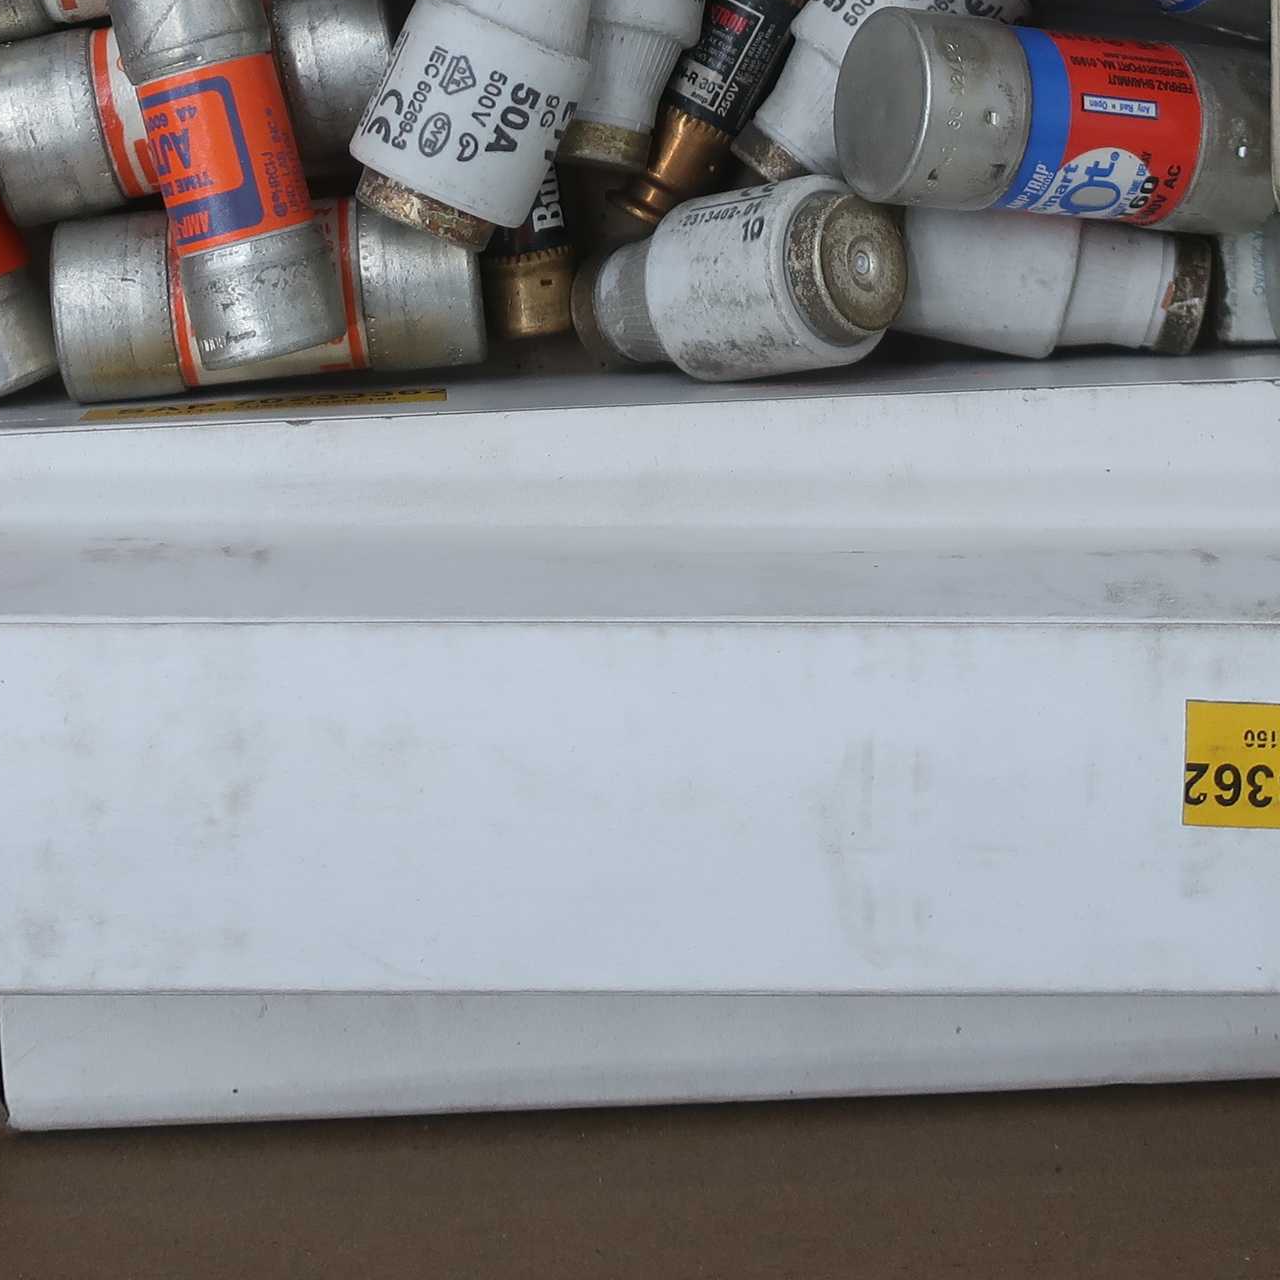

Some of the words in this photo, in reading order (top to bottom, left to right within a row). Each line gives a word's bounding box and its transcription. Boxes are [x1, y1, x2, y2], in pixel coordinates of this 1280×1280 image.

[424, 45, 448, 79] IEC
[471, 70, 508, 128] 500V
[717, 82, 740, 117] 250V
[1108, 75, 1155, 90] SHAWMUT
[1156, 79, 1193, 94] FERRAZ
[392, 80, 432, 151] 60269-3
[485, 82, 541, 153] 50A
[1089, 100, 1108, 110] Open
[1164, 165, 1181, 190] AC
